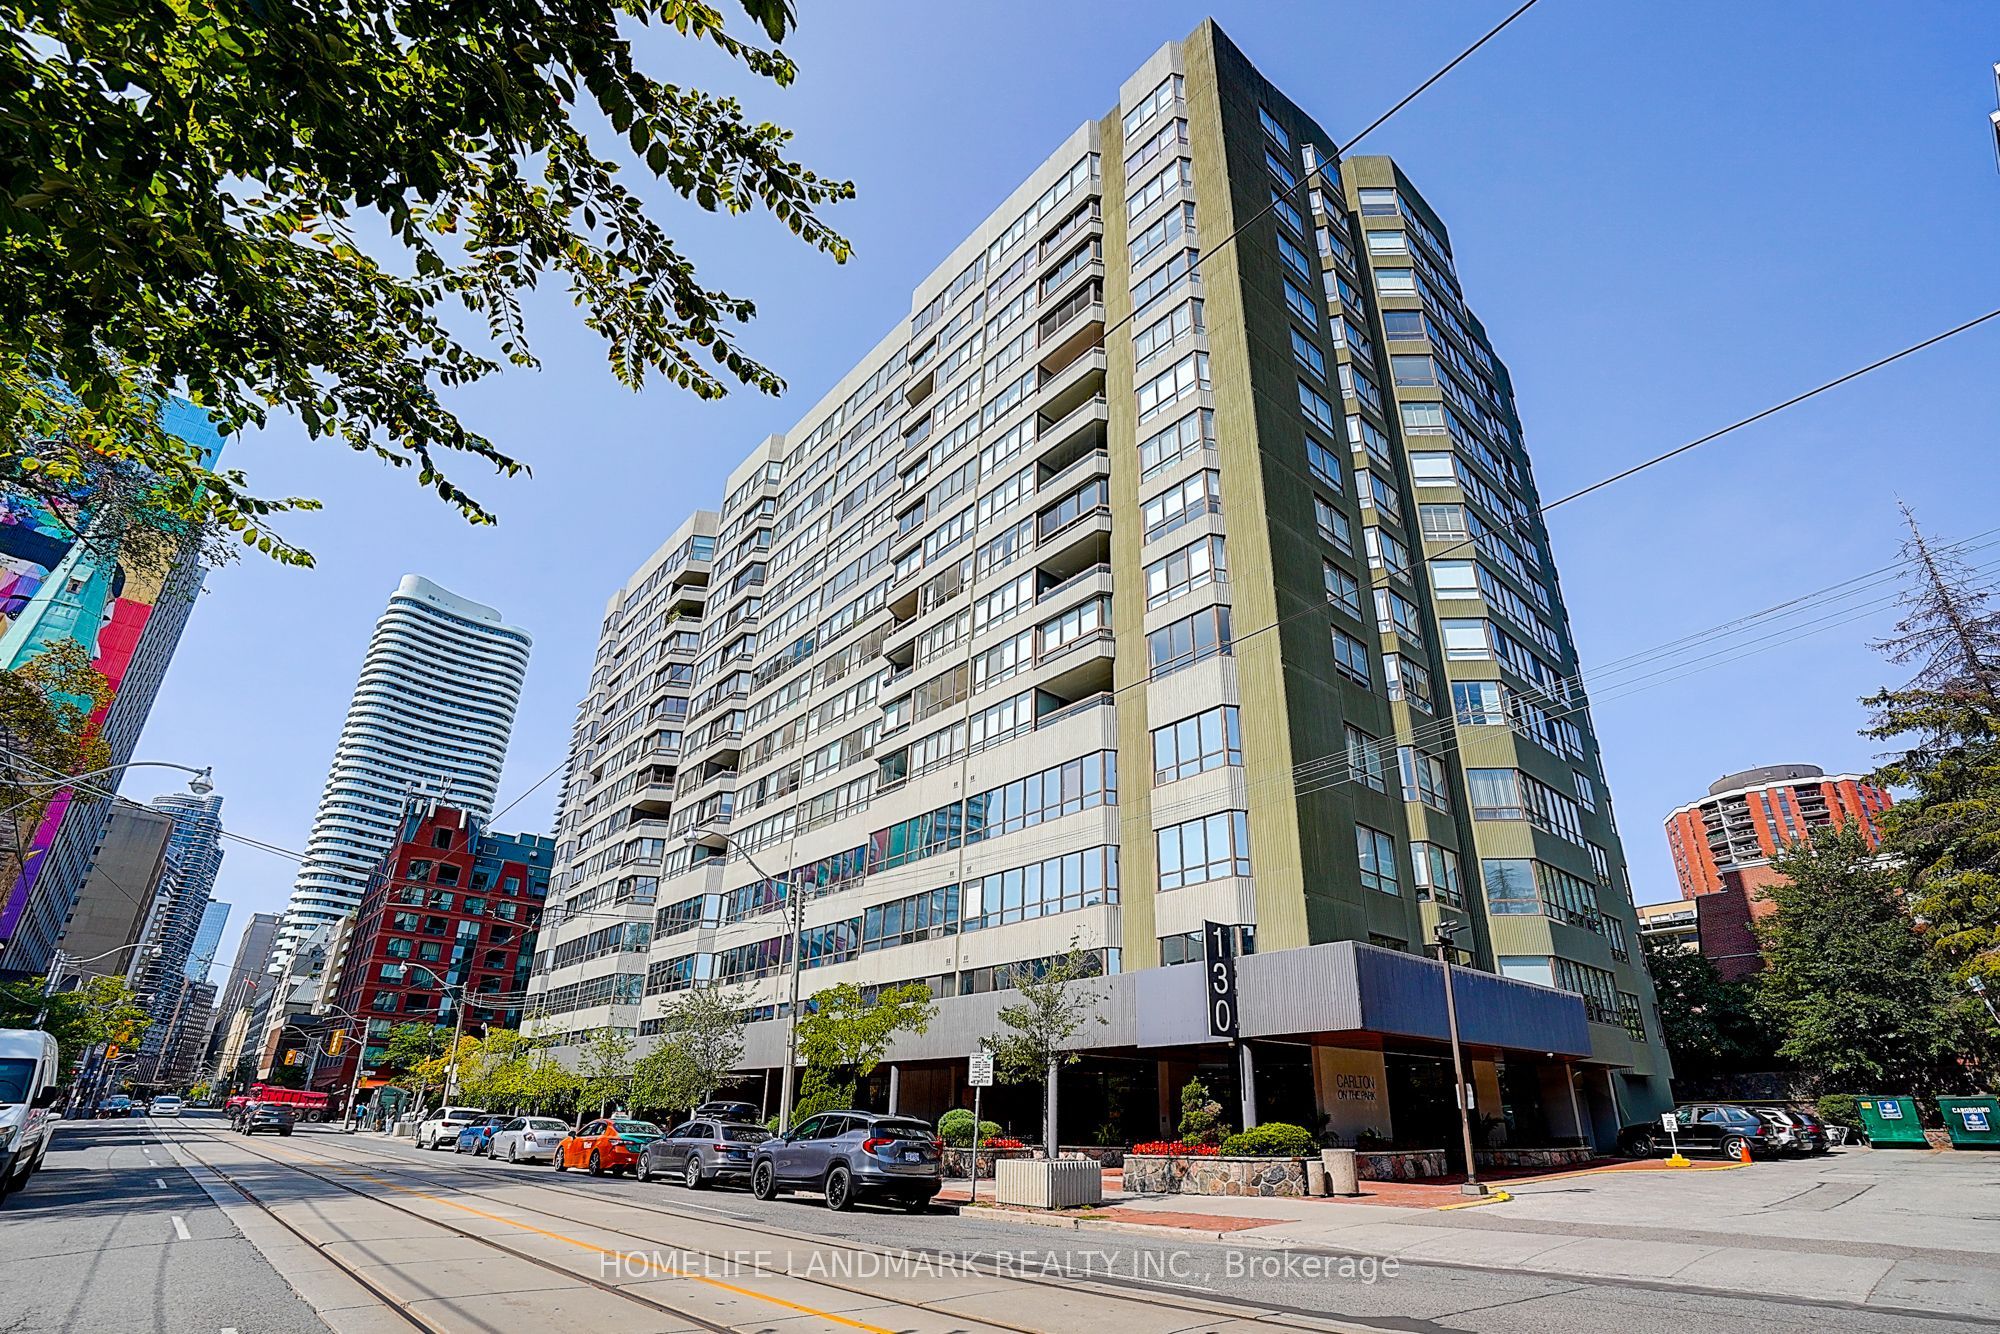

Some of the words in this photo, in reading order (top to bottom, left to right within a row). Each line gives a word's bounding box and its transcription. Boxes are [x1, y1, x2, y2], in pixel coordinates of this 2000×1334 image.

[1213, 927, 1230, 1032] 130
[1336, 1073, 1375, 1089] CARLTON
[1337, 1089, 1348, 1100] ON
[1348, 1090, 1360, 1100] THE
[1360, 1090, 1377, 1101] PARK
